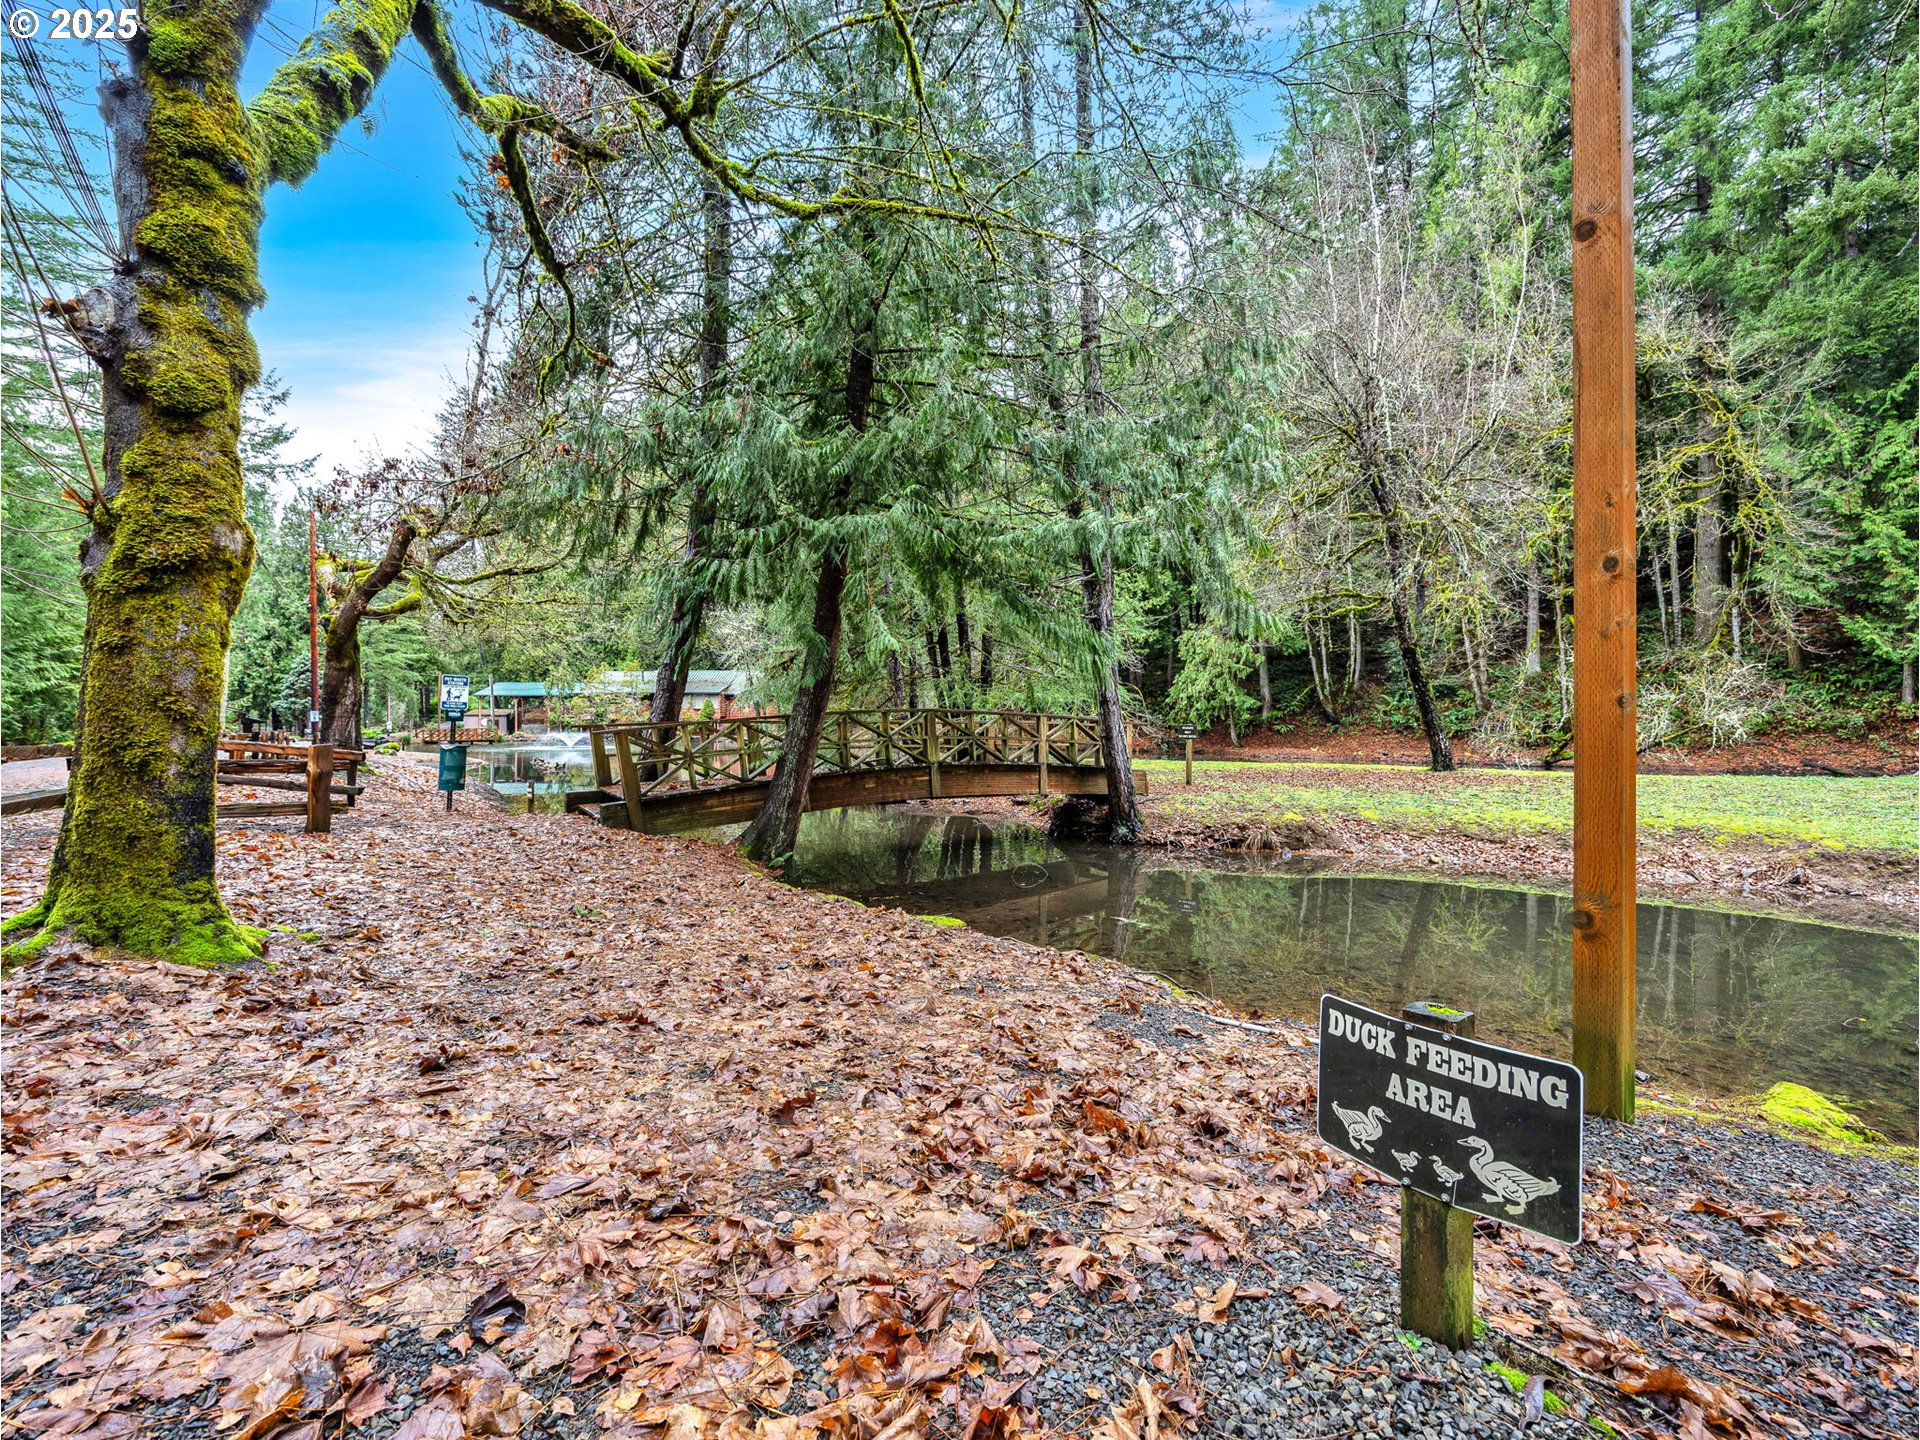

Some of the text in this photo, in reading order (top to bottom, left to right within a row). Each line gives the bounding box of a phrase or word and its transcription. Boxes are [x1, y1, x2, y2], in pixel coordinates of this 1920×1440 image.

[1328, 1008, 1569, 1109] DUCK FEEDING
[1385, 1073, 1476, 1129] AREA
